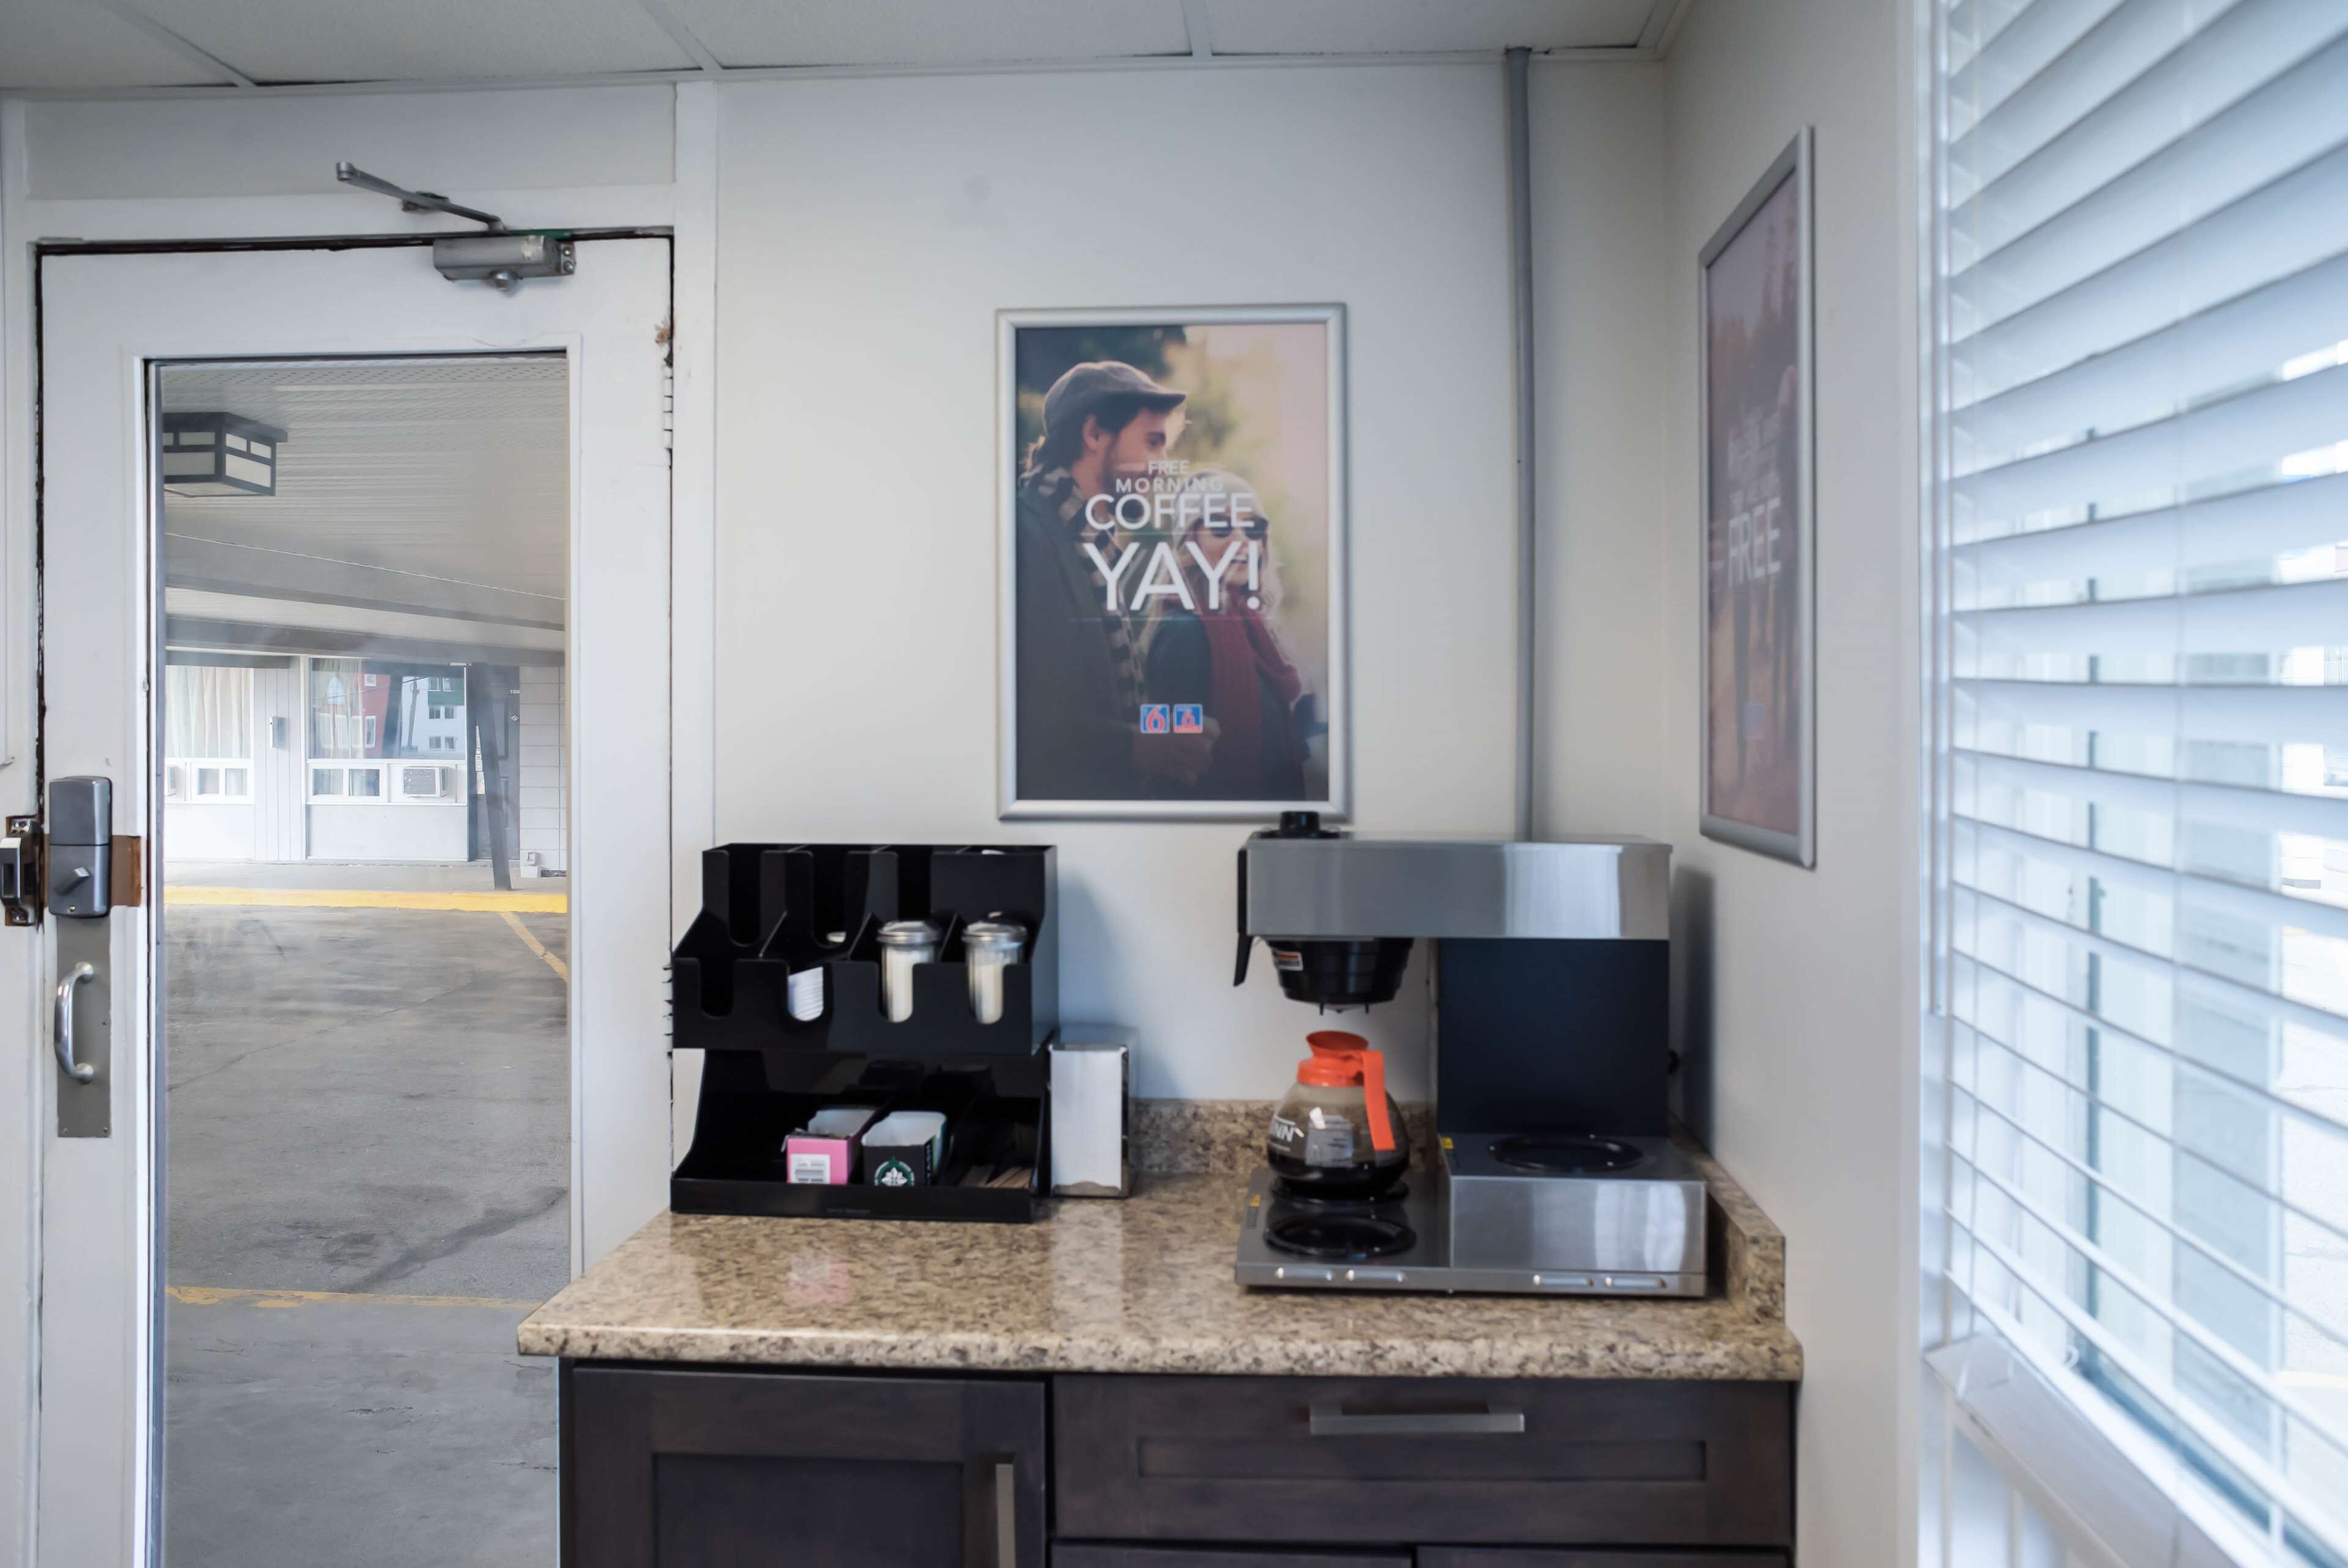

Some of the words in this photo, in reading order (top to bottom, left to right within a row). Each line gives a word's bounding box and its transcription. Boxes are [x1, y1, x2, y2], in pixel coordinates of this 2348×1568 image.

[1116, 476, 1223, 493] MORNING
[1149, 460, 1189, 475] FREE
[1085, 492, 1255, 530] COFFEE
[1728, 497, 1782, 587] FREE
[1083, 540, 1260, 611] YAY!
